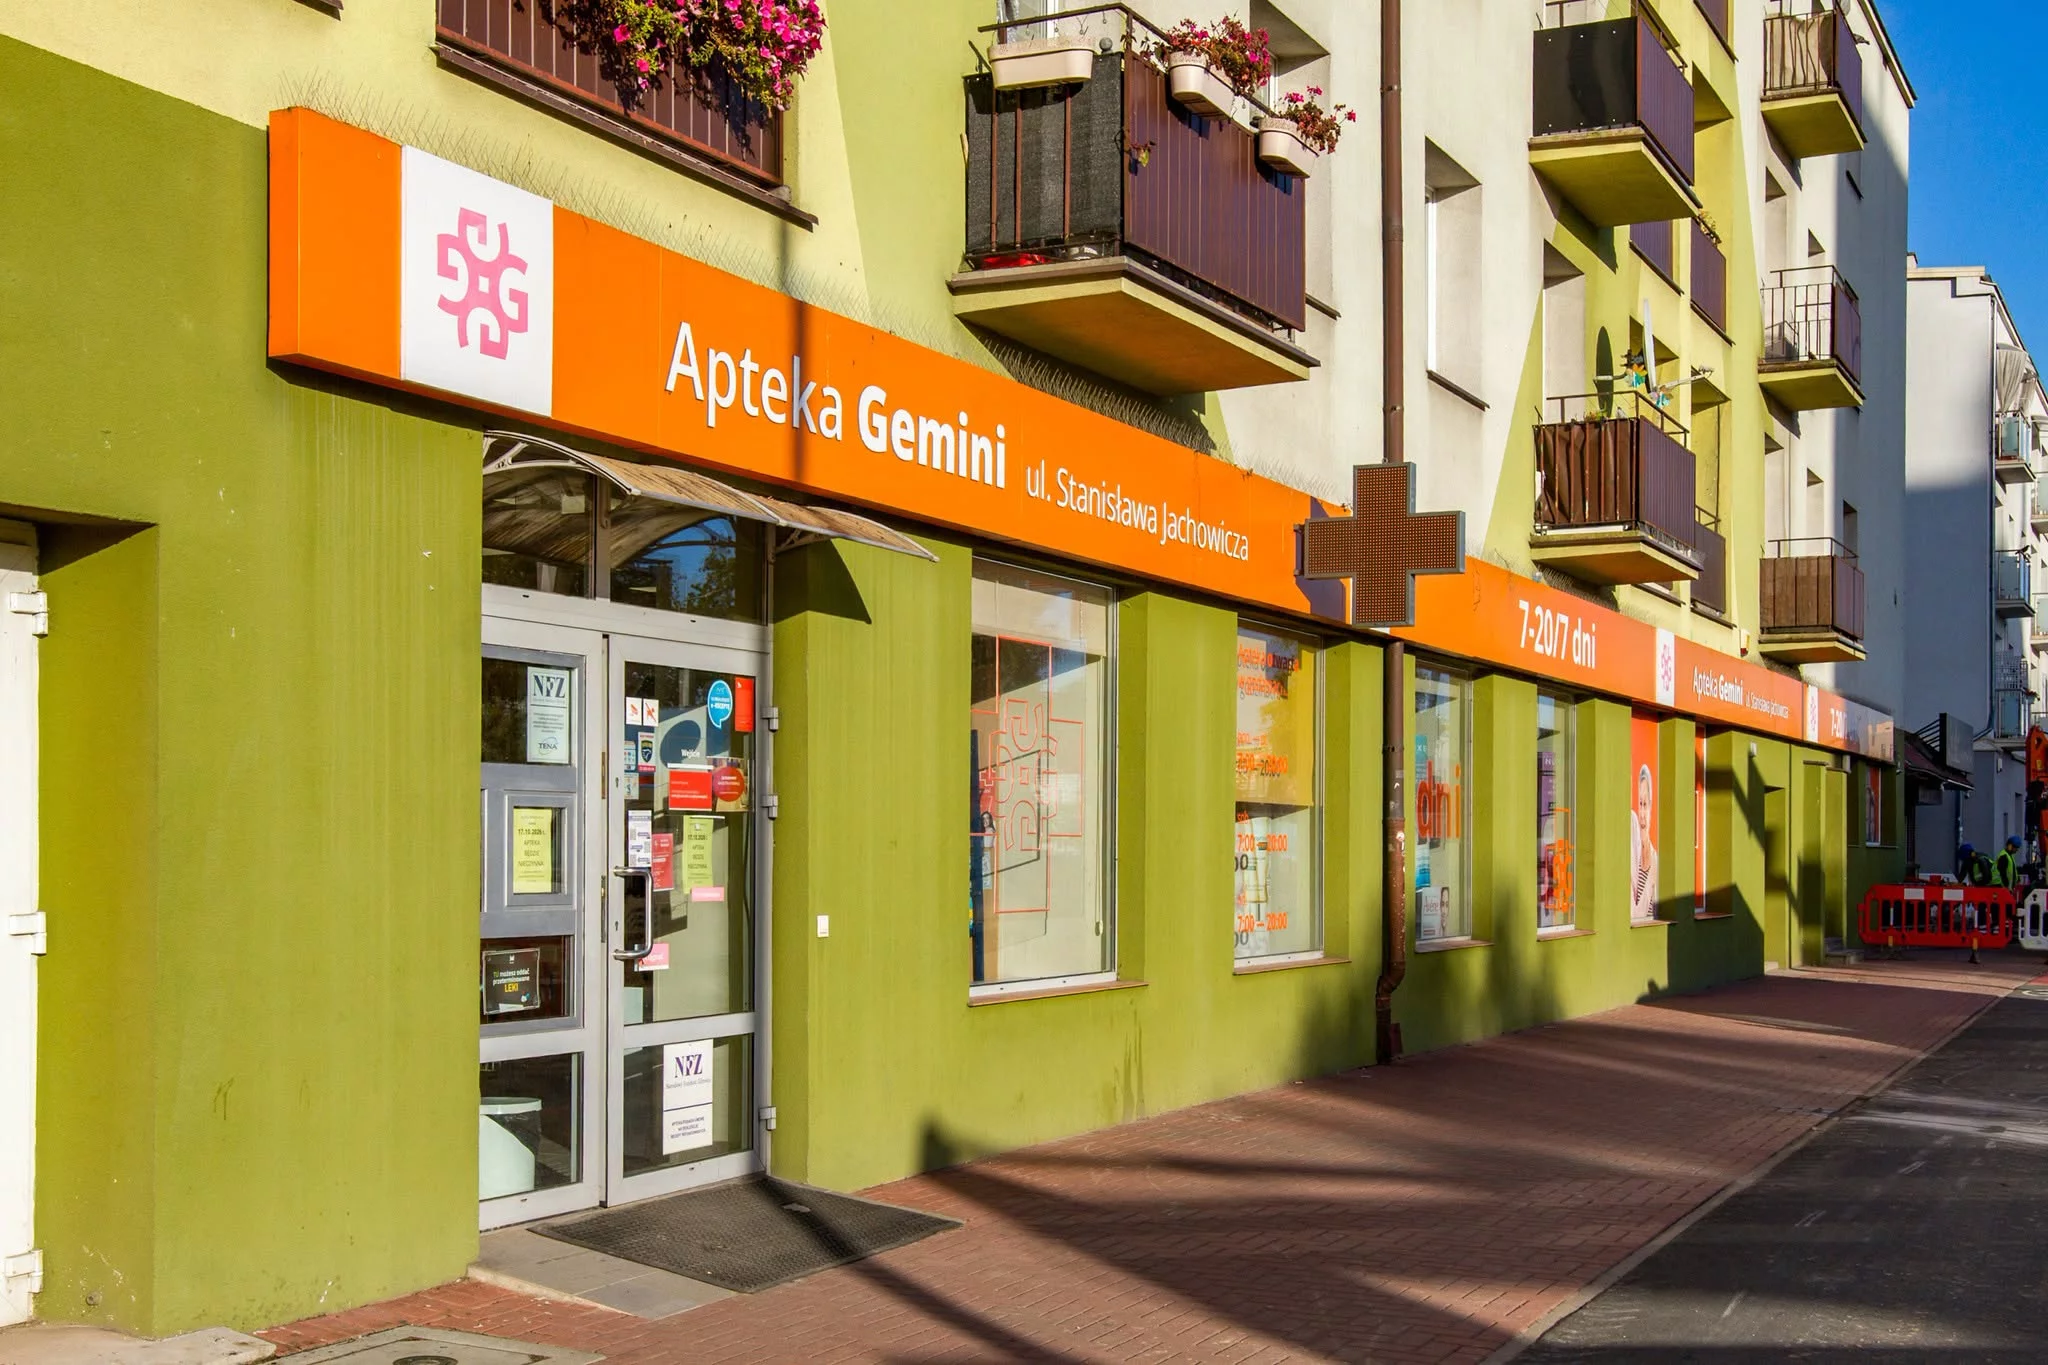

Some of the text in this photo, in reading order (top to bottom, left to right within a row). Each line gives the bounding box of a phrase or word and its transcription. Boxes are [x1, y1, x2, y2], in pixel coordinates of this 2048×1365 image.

[665, 321, 1249, 562] Apteka Gemini ul. Stanisława Jachowicza
[1518, 599, 1596, 670] 7-20/7 dni
[533, 674, 566, 698] NFZ
[1693, 666, 1718, 702] Apteka
[1718, 674, 1744, 705] Gemini
[538, 742, 558, 750] TENA
[1416, 759, 1461, 839] dni
[1237, 834, 1255, 851] 7:00
[1266, 834, 1288, 852] 20:00
[1237, 913, 1255, 933] 7:00
[1266, 911, 1288, 931] 20:00
[504, 982, 519, 992] LEKI
[674, 1053, 703, 1078] NFZ
